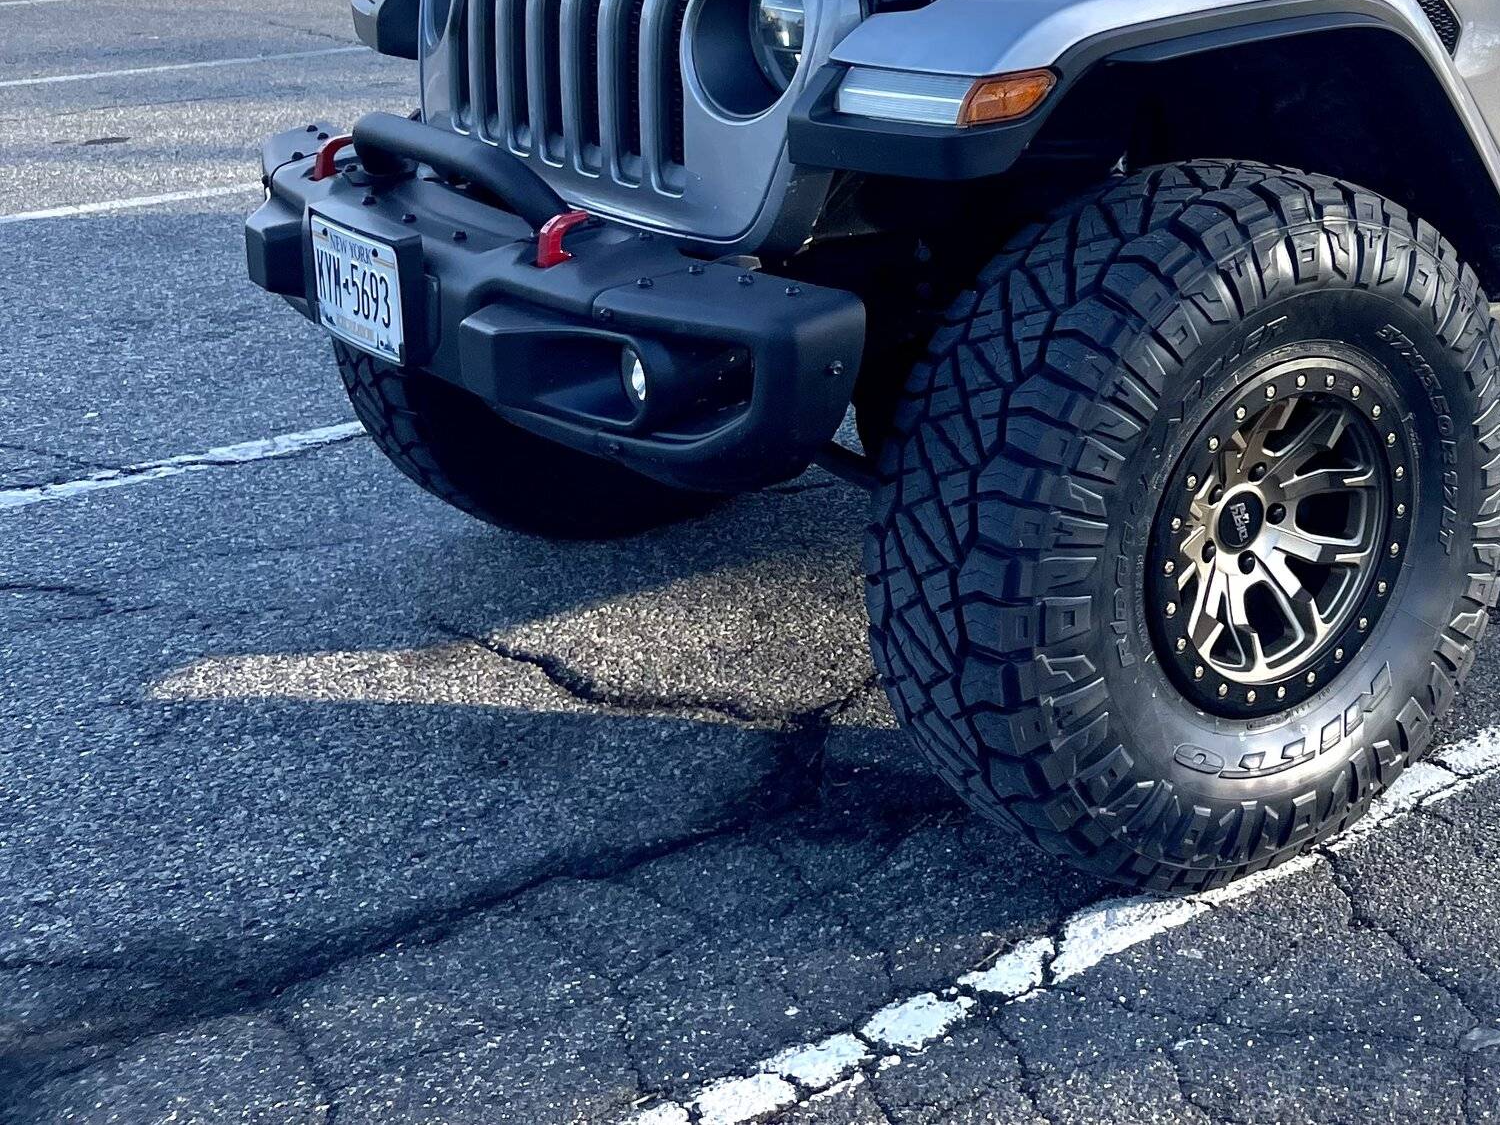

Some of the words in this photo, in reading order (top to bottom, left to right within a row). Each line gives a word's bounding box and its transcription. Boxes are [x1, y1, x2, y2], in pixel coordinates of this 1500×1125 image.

[329, 233, 348, 254] NEW
[348, 242, 373, 266] YORK
[1174, 660, 1393, 780] NITTO
